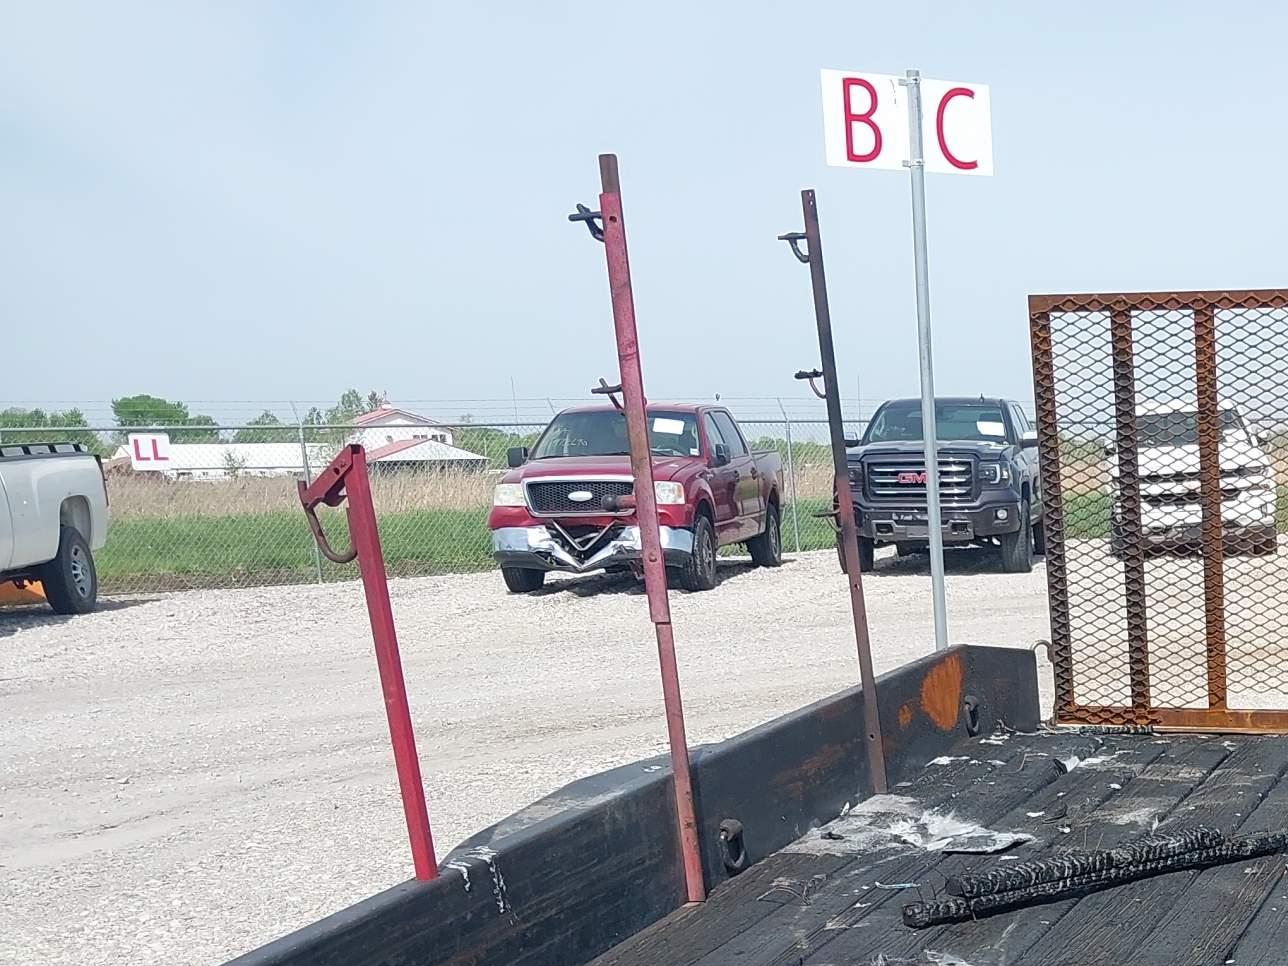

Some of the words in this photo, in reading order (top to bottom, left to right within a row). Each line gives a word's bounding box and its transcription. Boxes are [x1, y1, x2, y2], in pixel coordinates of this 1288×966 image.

[843, 77, 882, 163] B
[936, 87, 978, 170] C
[134, 439, 169, 461] LL
[897, 473, 928, 484] GM
